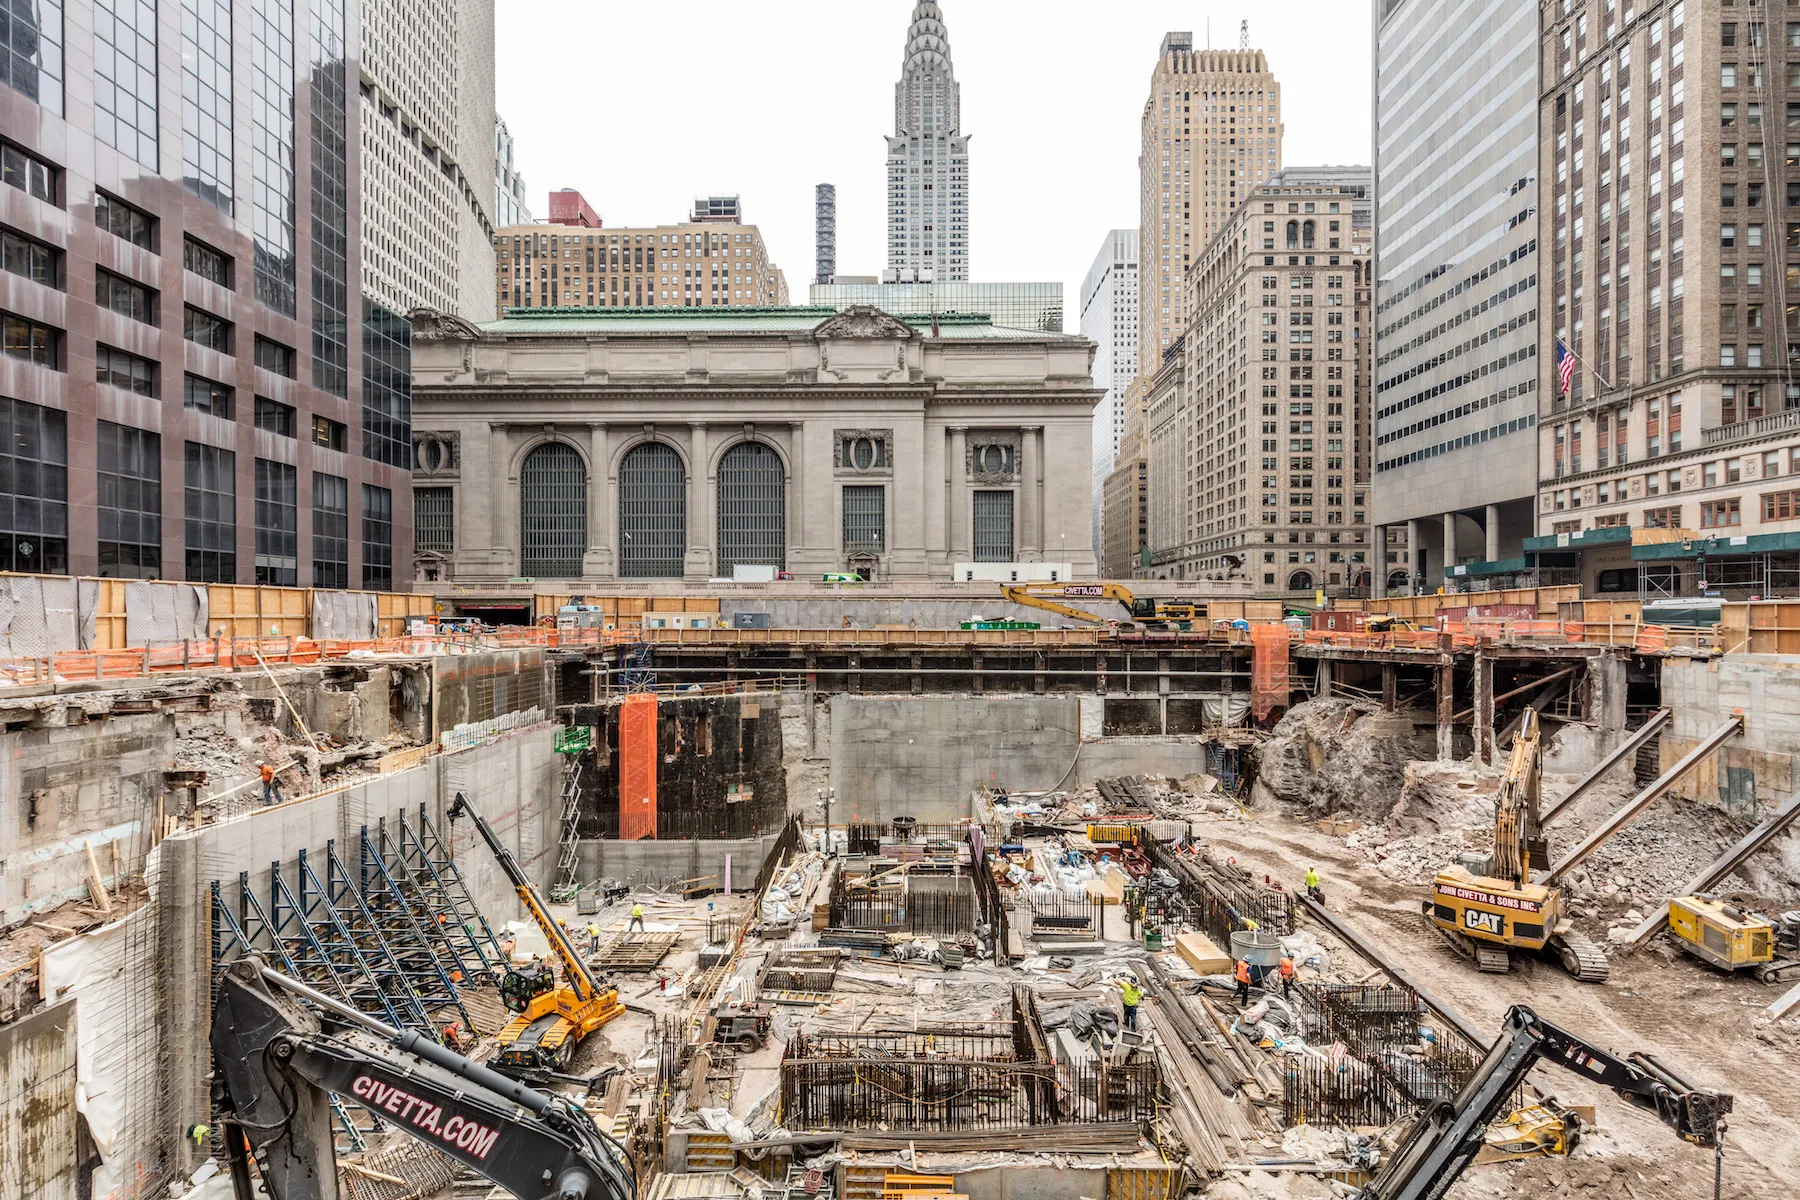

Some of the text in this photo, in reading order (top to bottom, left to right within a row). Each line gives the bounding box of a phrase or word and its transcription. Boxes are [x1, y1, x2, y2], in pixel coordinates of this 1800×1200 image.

[1064, 586, 1102, 595] CIVETTA.COM
[1439, 885, 1538, 912] JOHN CIVETTA & SONS INC.
[1466, 910, 1501, 933] CAT
[352, 1075, 500, 1160] CIVETTA.COM
